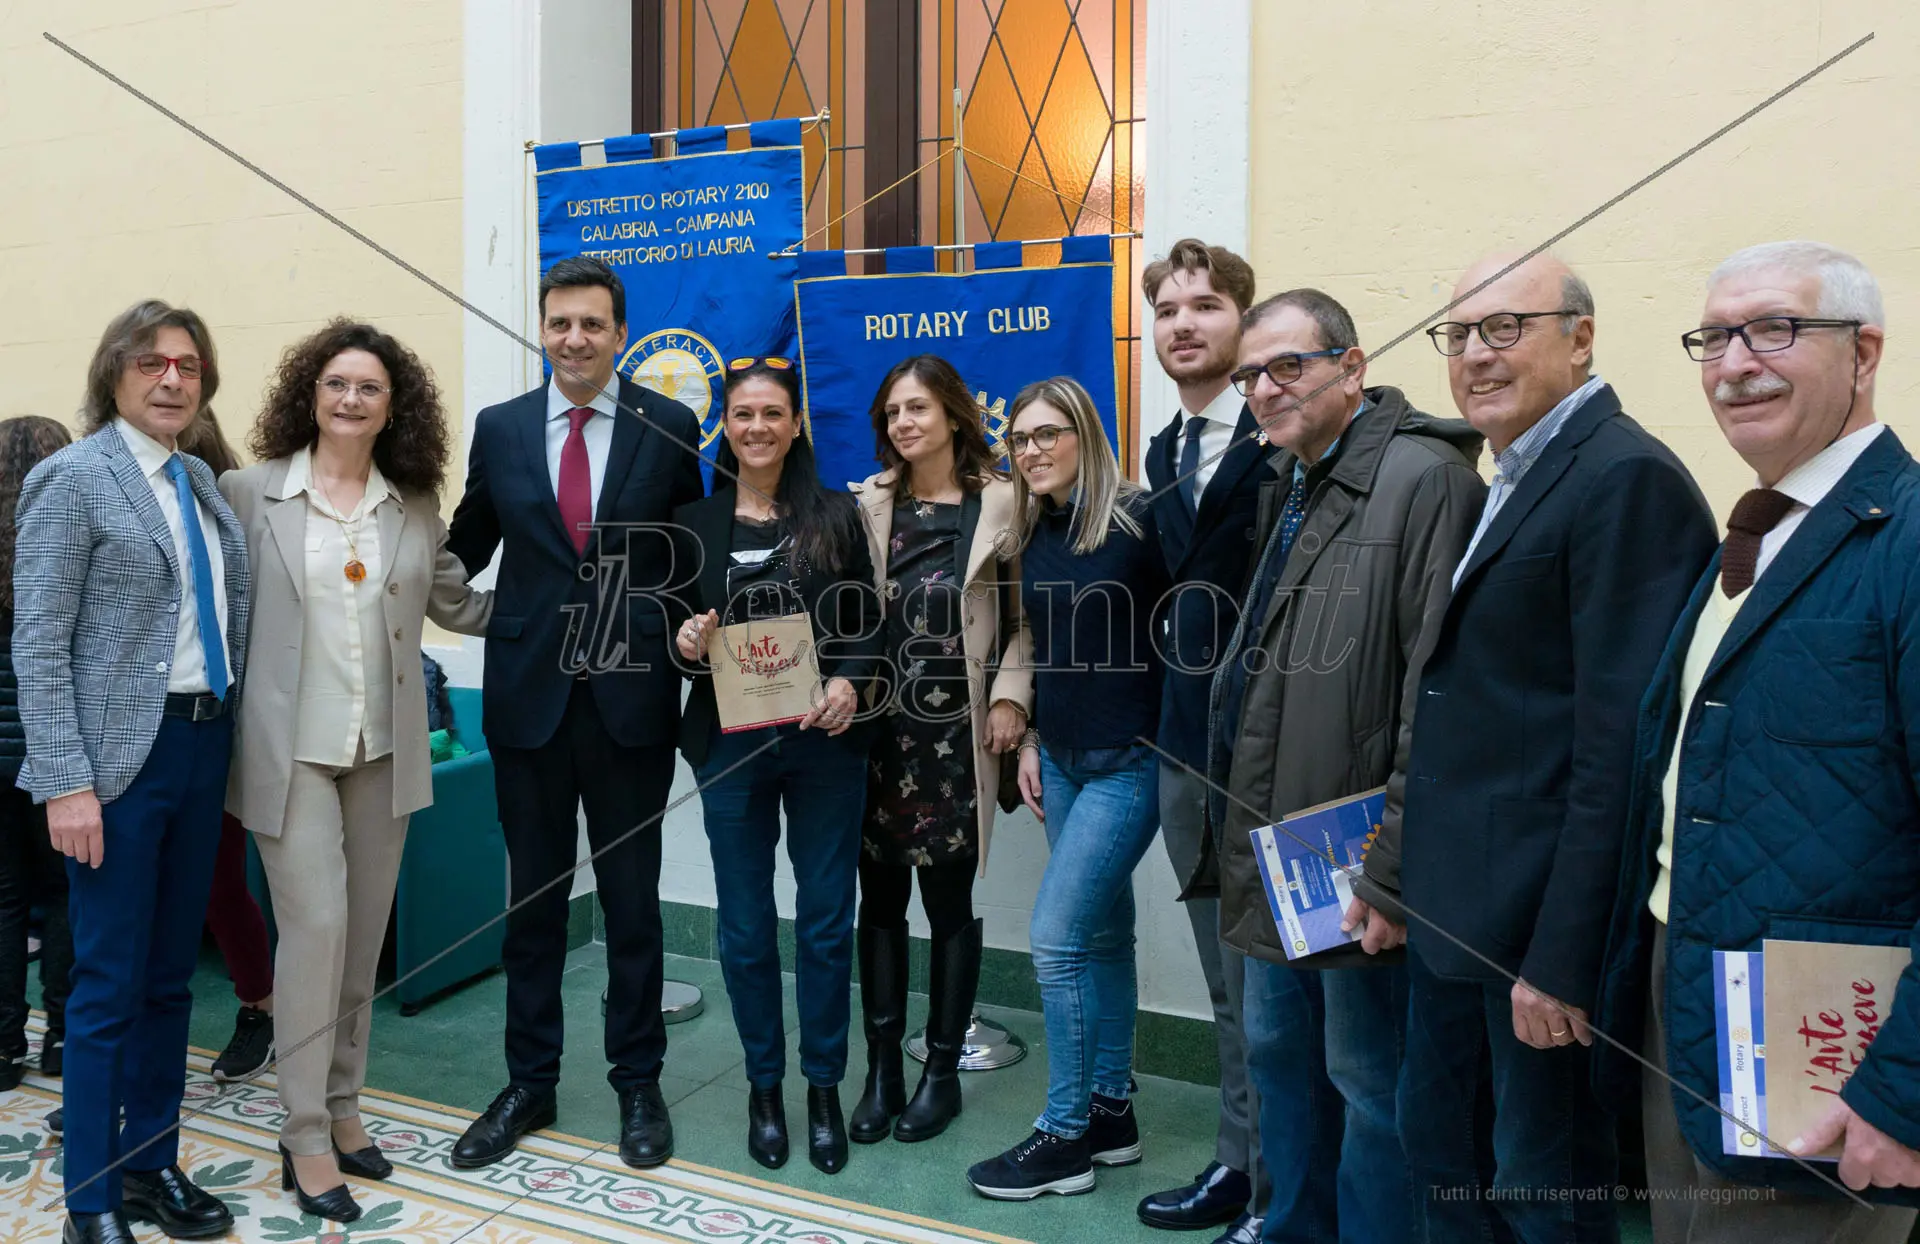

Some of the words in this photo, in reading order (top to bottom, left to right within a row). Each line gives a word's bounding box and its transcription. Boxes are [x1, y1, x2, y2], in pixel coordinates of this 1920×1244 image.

[567, 193, 655, 217] DISTRETTO
[661, 185, 730, 209] ROTARY
[735, 182, 769, 200] 2100
[581, 220, 659, 242] CALABRIA
[676, 209, 755, 234] CAMPANIA
[681, 242, 693, 260] DI
[698, 236, 755, 257] LAURIA
[864, 310, 968, 340] ROTARY
[988, 306, 1050, 333] CLUB
[623, 335, 717, 376] INTERACT
[746, 578, 803, 606] SHE
[738, 635, 781, 662] L'Arte
[1736, 1044, 1745, 1072] Rotary
